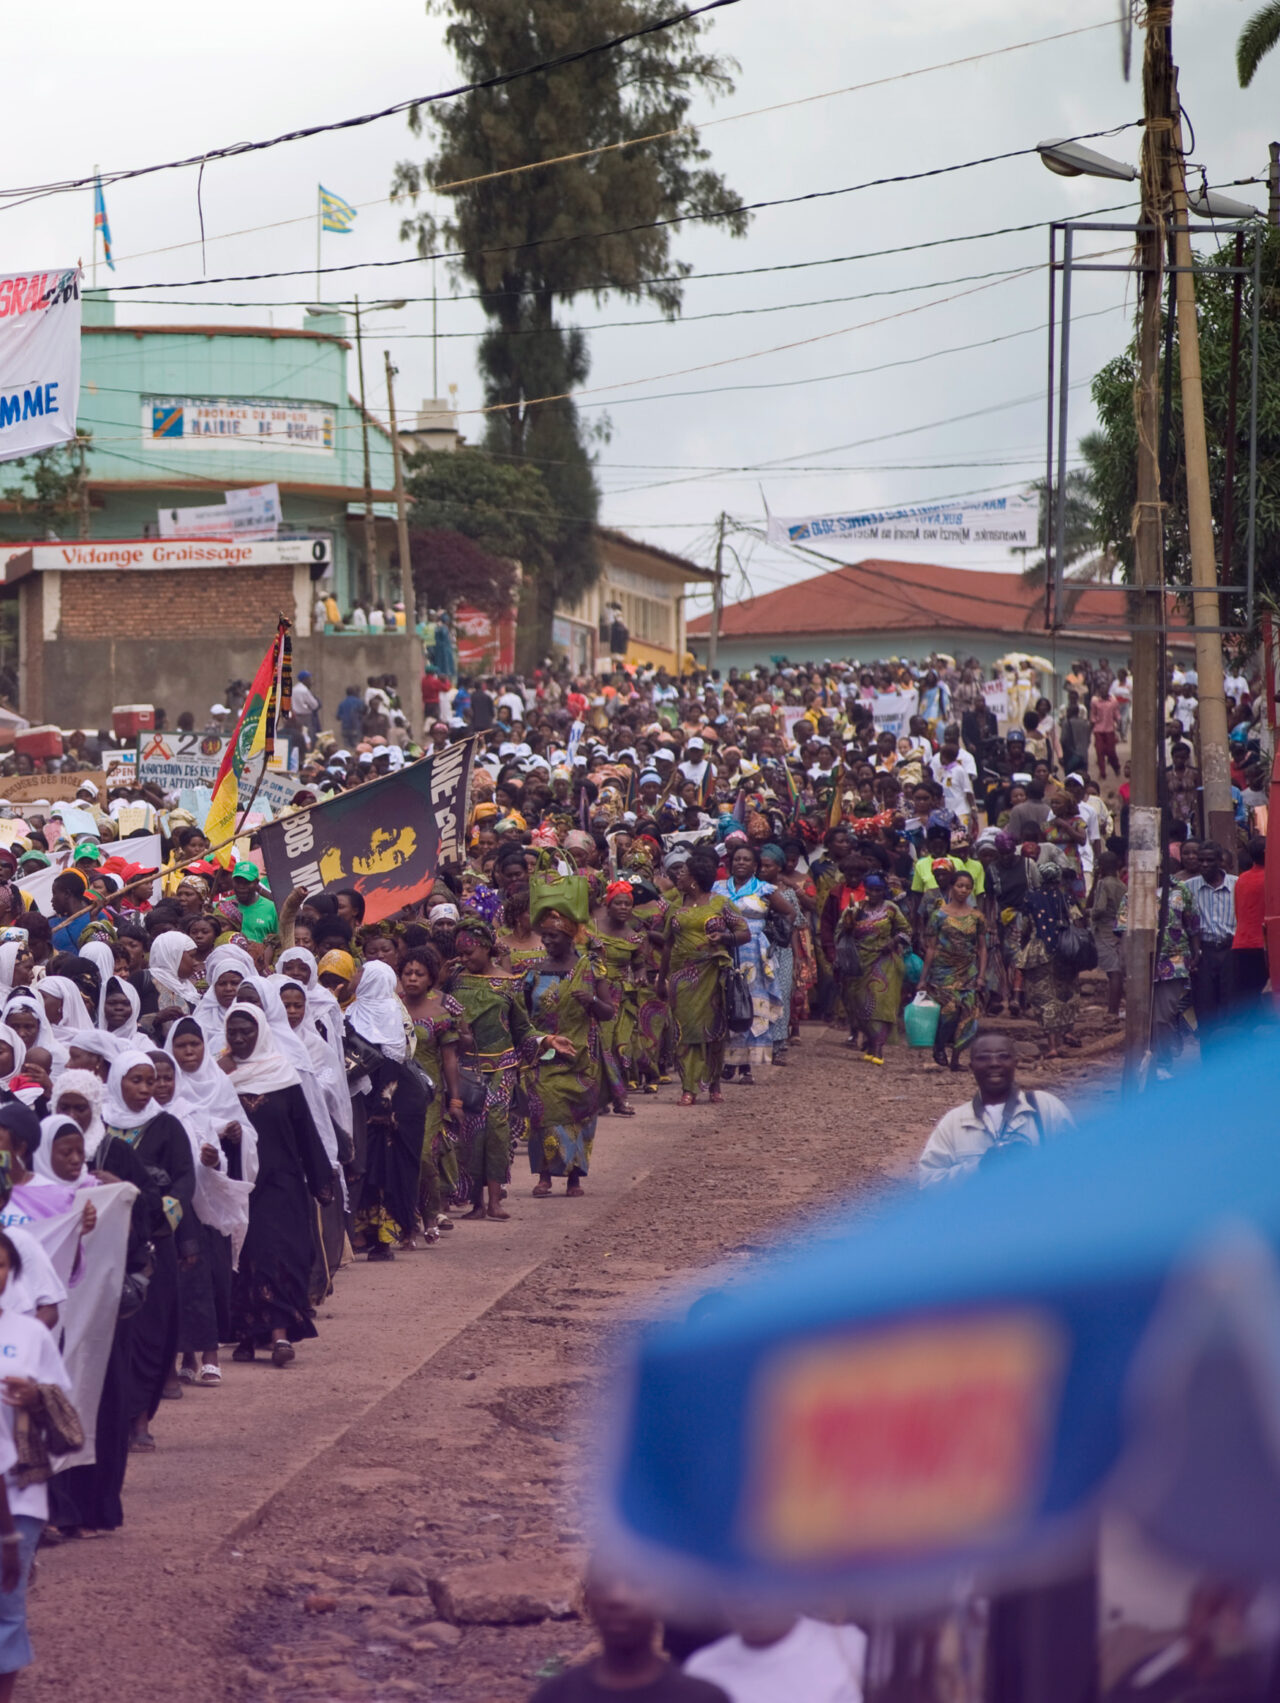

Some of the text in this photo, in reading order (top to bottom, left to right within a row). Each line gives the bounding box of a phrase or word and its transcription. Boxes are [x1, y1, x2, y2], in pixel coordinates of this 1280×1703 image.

[192, 420, 240, 435] MAIRIE
[62, 545, 252, 568] Vidange Graissage
[430, 743, 468, 805] ONE
[281, 811, 325, 908] BOB MA
